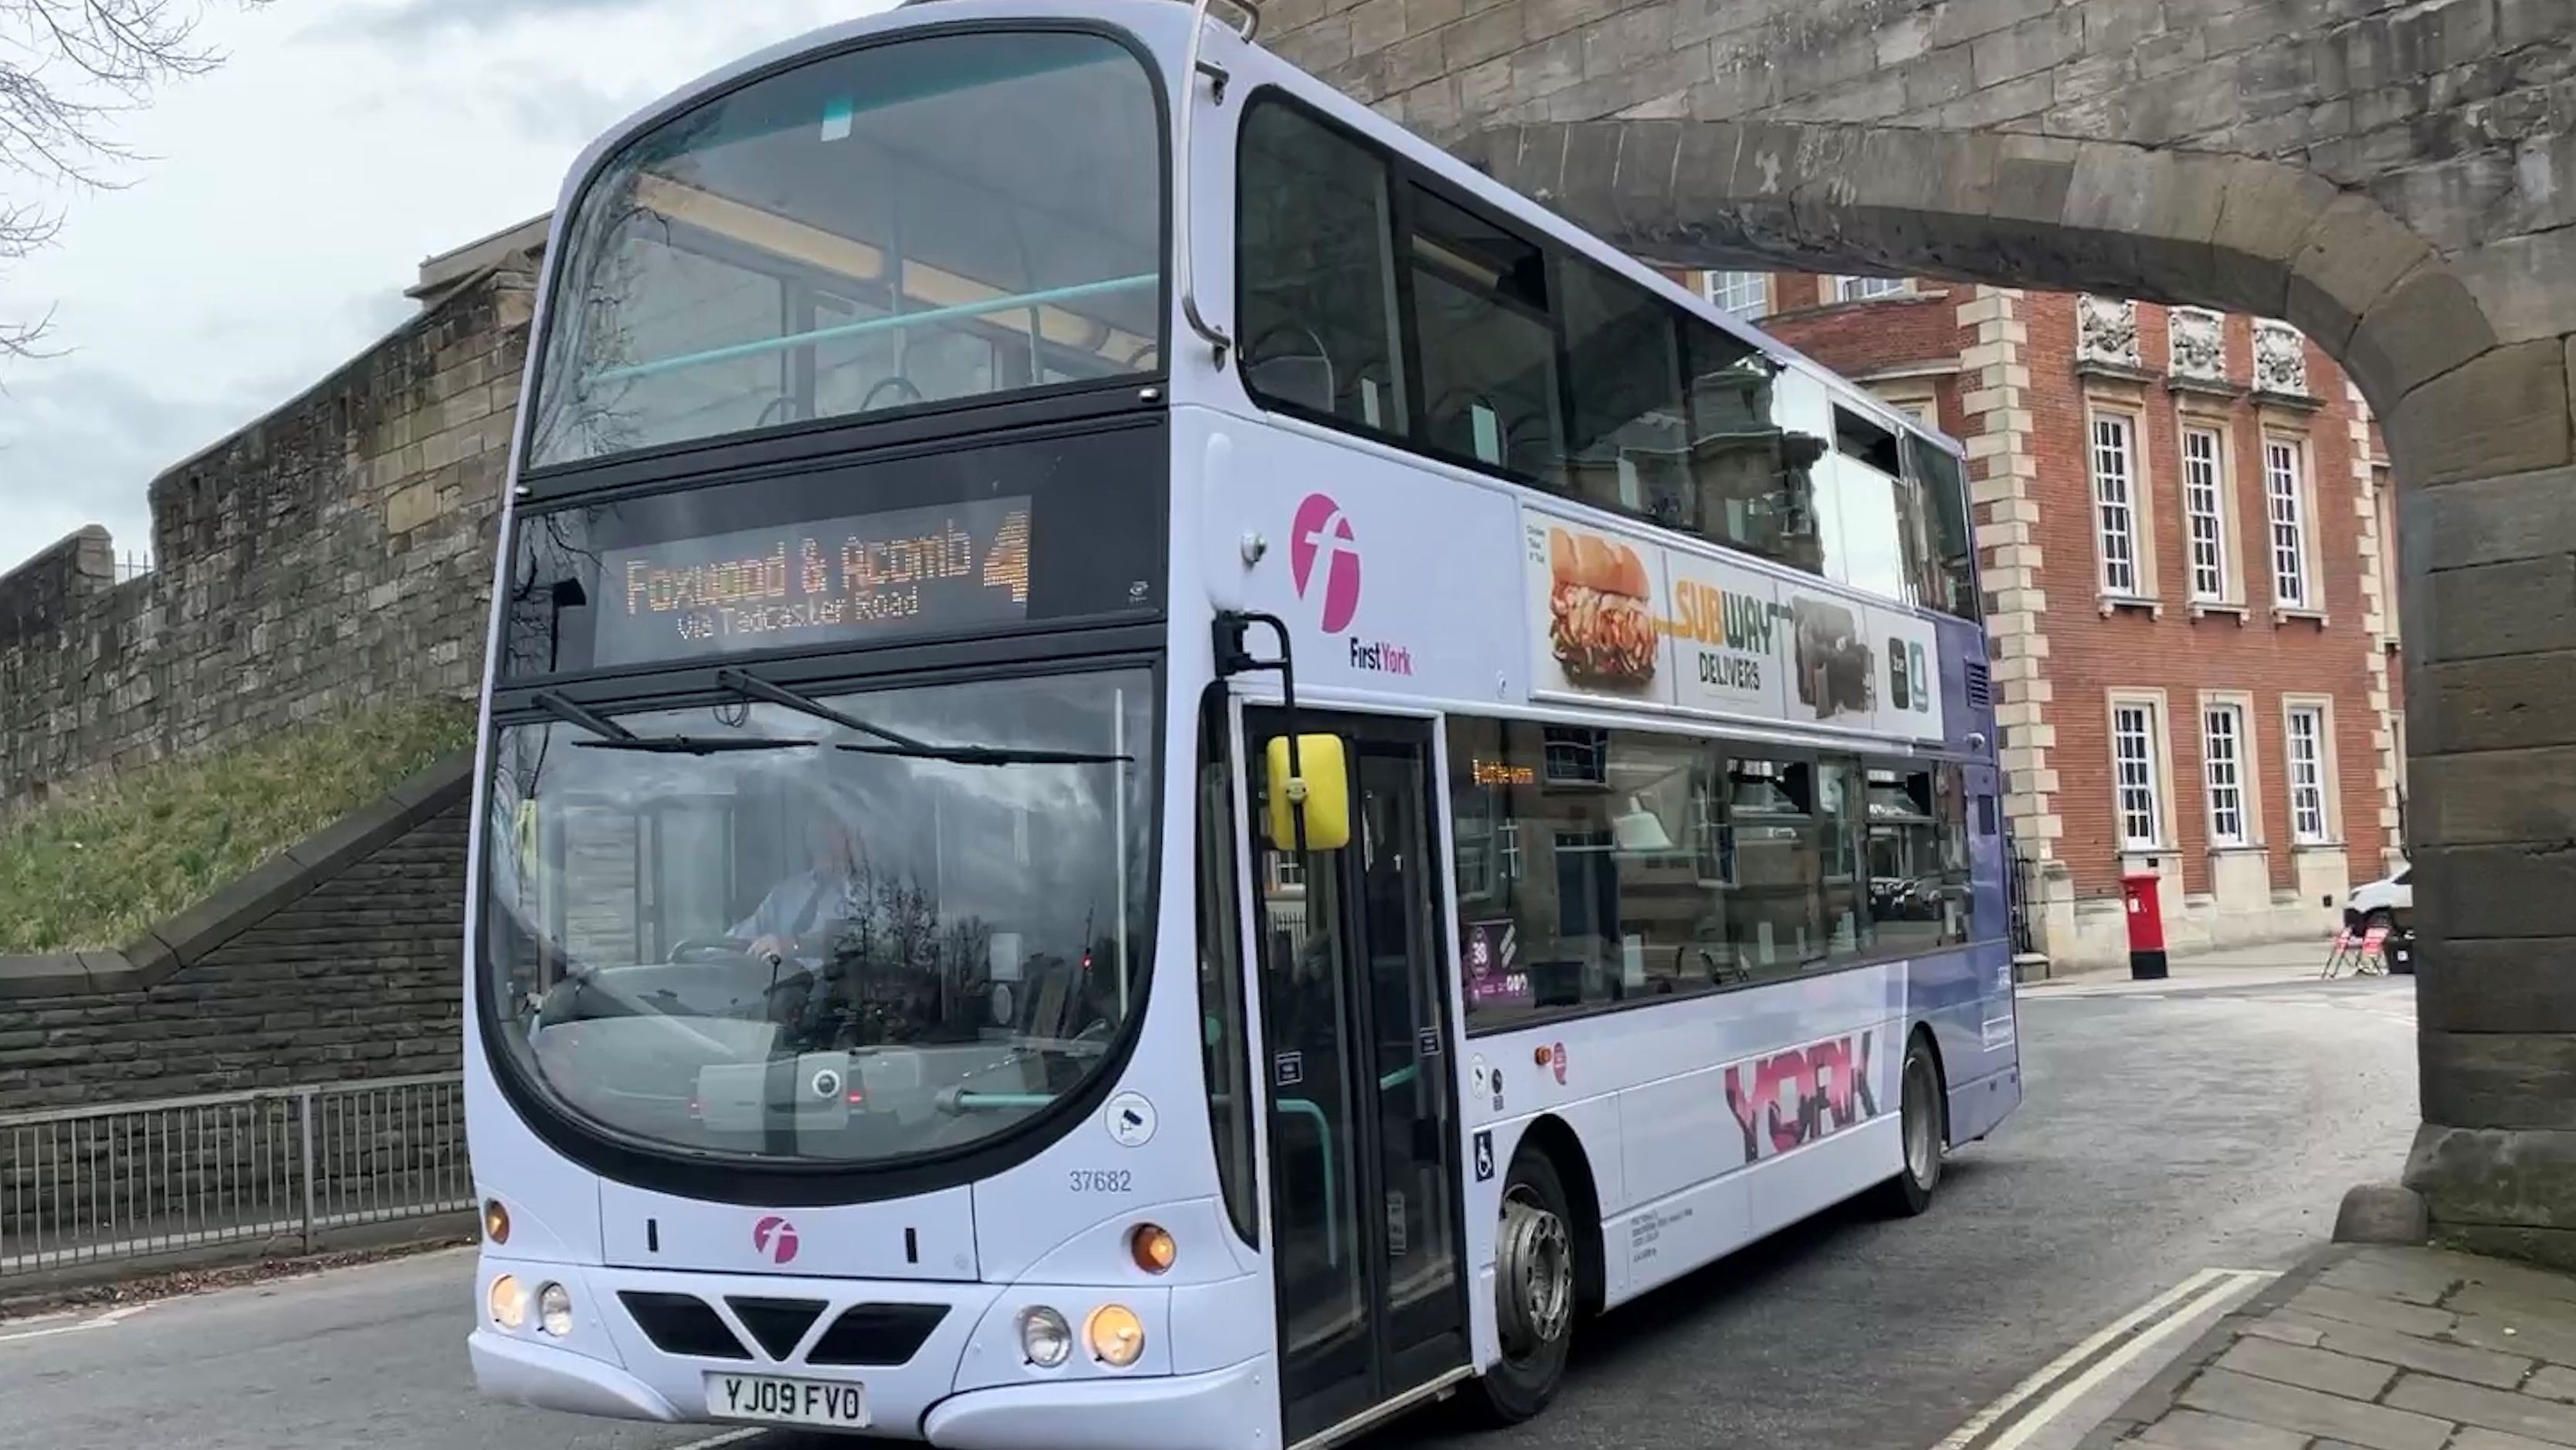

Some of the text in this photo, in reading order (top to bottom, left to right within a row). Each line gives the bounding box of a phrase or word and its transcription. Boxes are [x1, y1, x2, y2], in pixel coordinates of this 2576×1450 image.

[626, 510, 1029, 618] Foxwood & Acomb 4
[676, 585, 920, 640] via Tadcaster Road
[1655, 579, 1792, 655] SUBWAY
[1699, 652, 1761, 691] DELIVERS
[1724, 1031, 1879, 1164] YORK
[1069, 1169, 1132, 1192] 37682
[726, 1378, 795, 1415] YJ09
